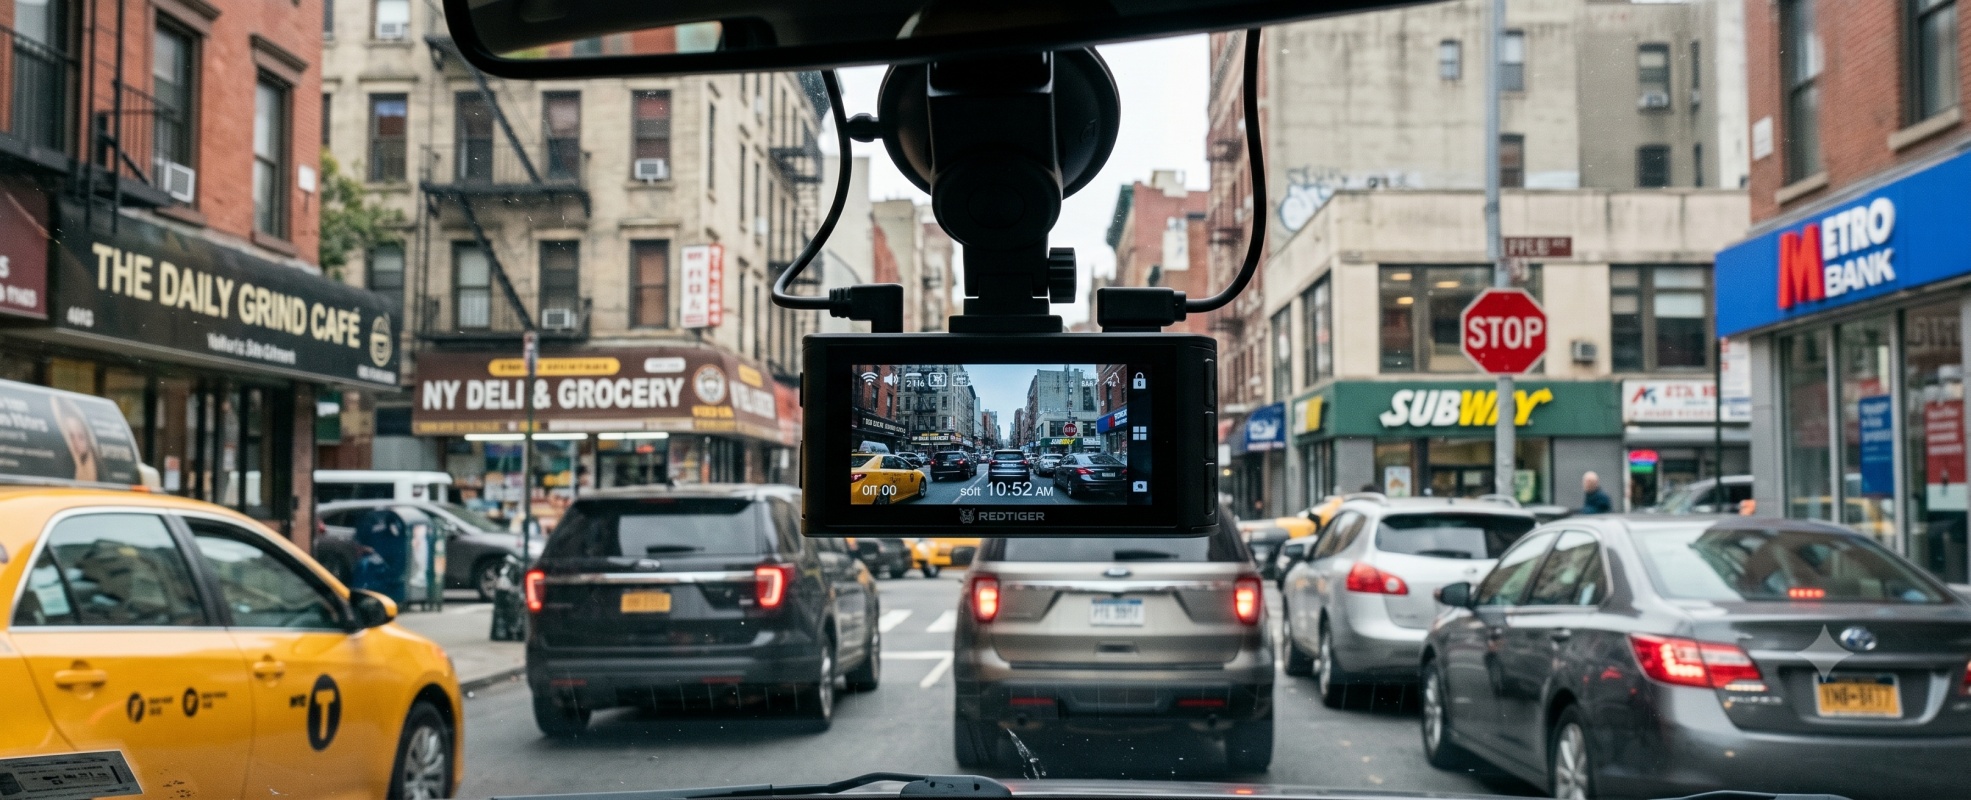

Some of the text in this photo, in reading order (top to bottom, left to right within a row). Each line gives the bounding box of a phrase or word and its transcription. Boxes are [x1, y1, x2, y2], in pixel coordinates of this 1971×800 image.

[1778, 197, 1895, 309] METRO
[1824, 247, 1896, 298] BANK
[92, 242, 153, 301] THE
[159, 261, 234, 318] DAILY
[238, 284, 307, 336] GRIND
[311, 304, 361, 349] CAFÉ
[1467, 315, 1544, 349] STOP
[422, 377, 685, 410] NY DELI & GROCERY
[986, 481, 1032, 497] 10:52
[1035, 487, 1054, 497] AM
[978, 511, 1045, 521] REDTIGER
[315, 689, 336, 741] T
